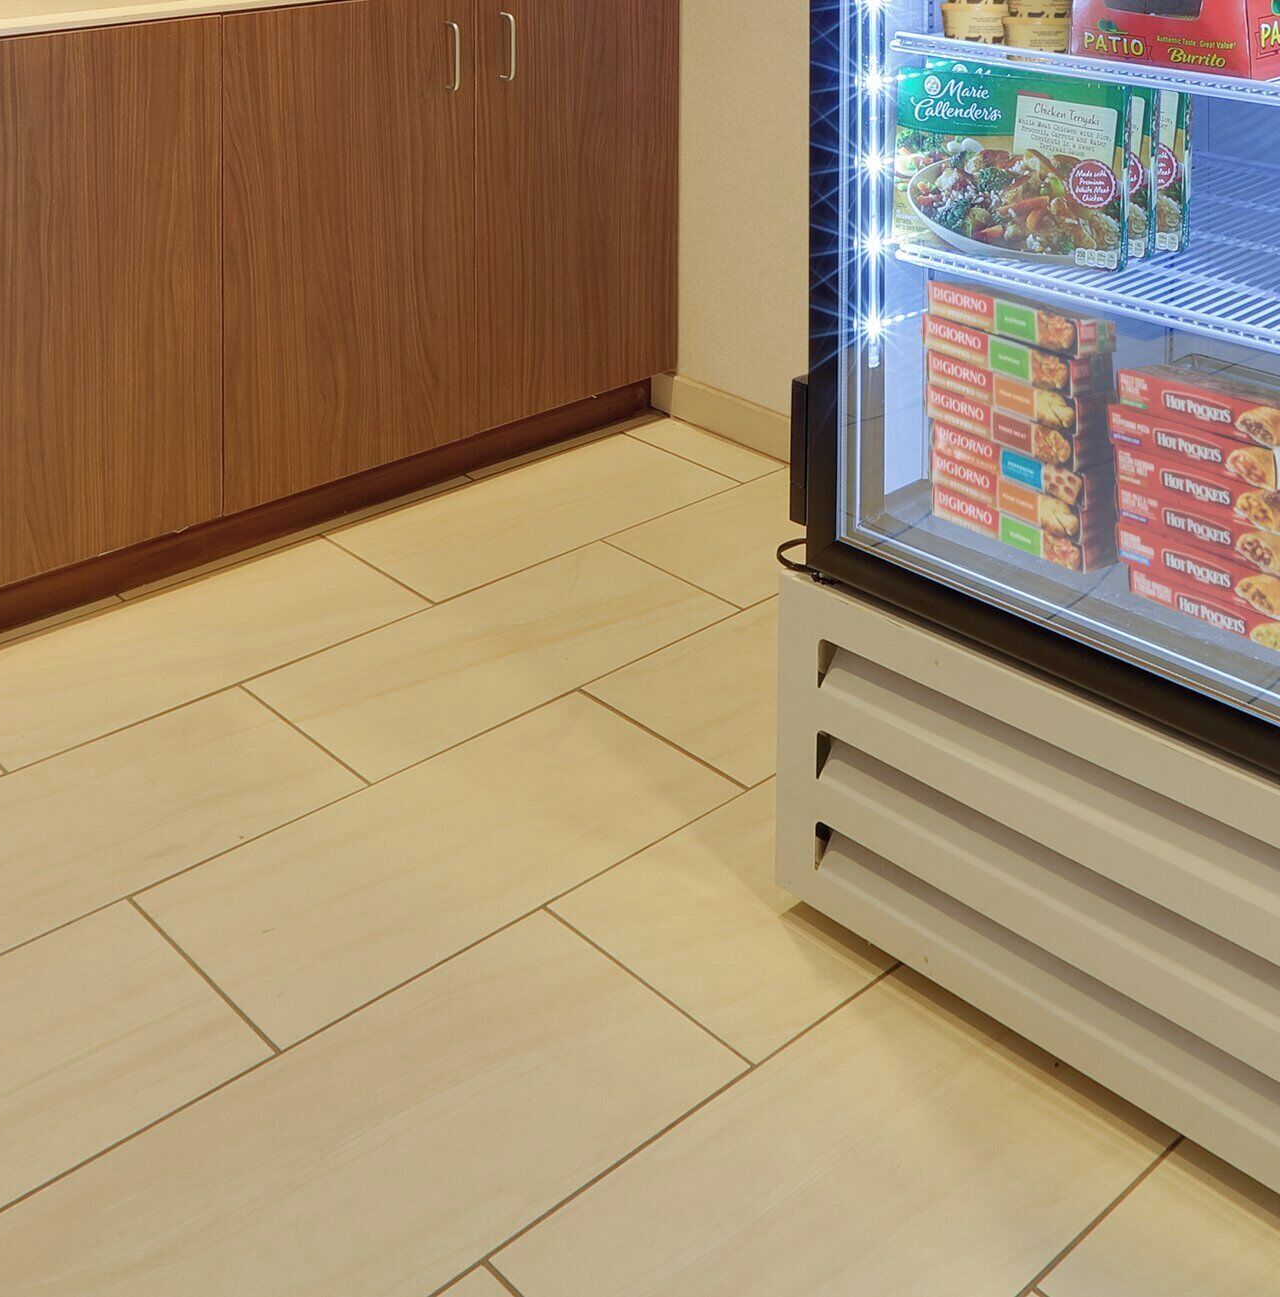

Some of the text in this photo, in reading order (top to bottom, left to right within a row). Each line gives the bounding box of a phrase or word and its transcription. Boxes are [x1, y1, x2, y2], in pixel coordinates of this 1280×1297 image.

[1084, 32, 1145, 57] PATIO
[1157, 35, 1236, 50] Authentic Great Value!
[1167, 47, 1226, 68] Burrito
[940, 77, 990, 100] Marie
[909, 94, 1002, 122] Callender's
[1033, 102, 1100, 126] Chicken Teriyaki
[1051, 131, 1074, 141] Carrots
[1079, 130, 1094, 138] with
[1079, 178, 1105, 186] Premium
[1082, 194, 1104, 202] Chicken
[933, 286, 987, 314] DIGIORNO
[928, 319, 982, 350] DIGIORNO
[932, 356, 986, 387] DIGIORNO
[931, 390, 985, 422] DIGIORNO
[1165, 393, 1186, 411] HOT
[1186, 398, 1232, 425] POCKETS
[938, 426, 993, 458] DIGIORNO
[1157, 431, 1222, 463] HOT POCKETS
[935, 456, 990, 489] DIGIORNO
[1163, 472, 1184, 490] HOT
[1185, 477, 1231, 506] POCKETS
[938, 492, 993, 525] DIGIORNO
[1165, 511, 1232, 546] HOT POCKETS
[1186, 559, 1232, 588] POCKETS
[1200, 604, 1246, 635] POCKETS
